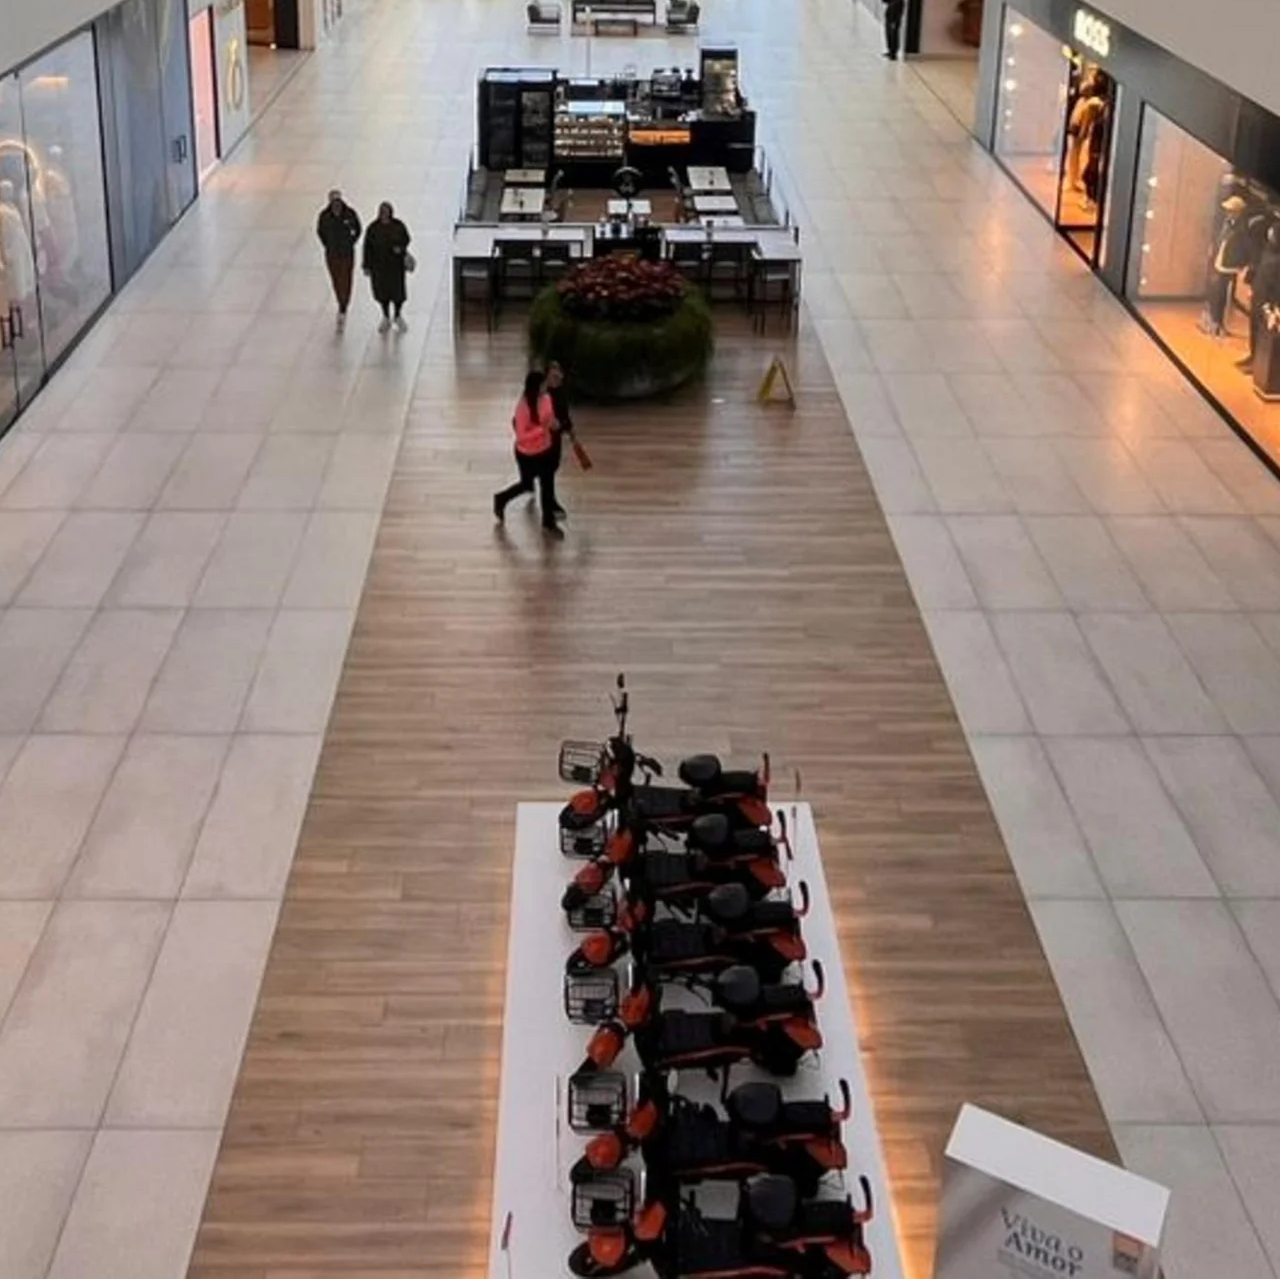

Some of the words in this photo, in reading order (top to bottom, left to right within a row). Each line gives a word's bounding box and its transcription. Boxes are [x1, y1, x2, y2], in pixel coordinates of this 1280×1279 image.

[1000, 1205, 1061, 1253] Viva
[1067, 1245, 1084, 1262] o
[1004, 1231, 1084, 1278] Amor
